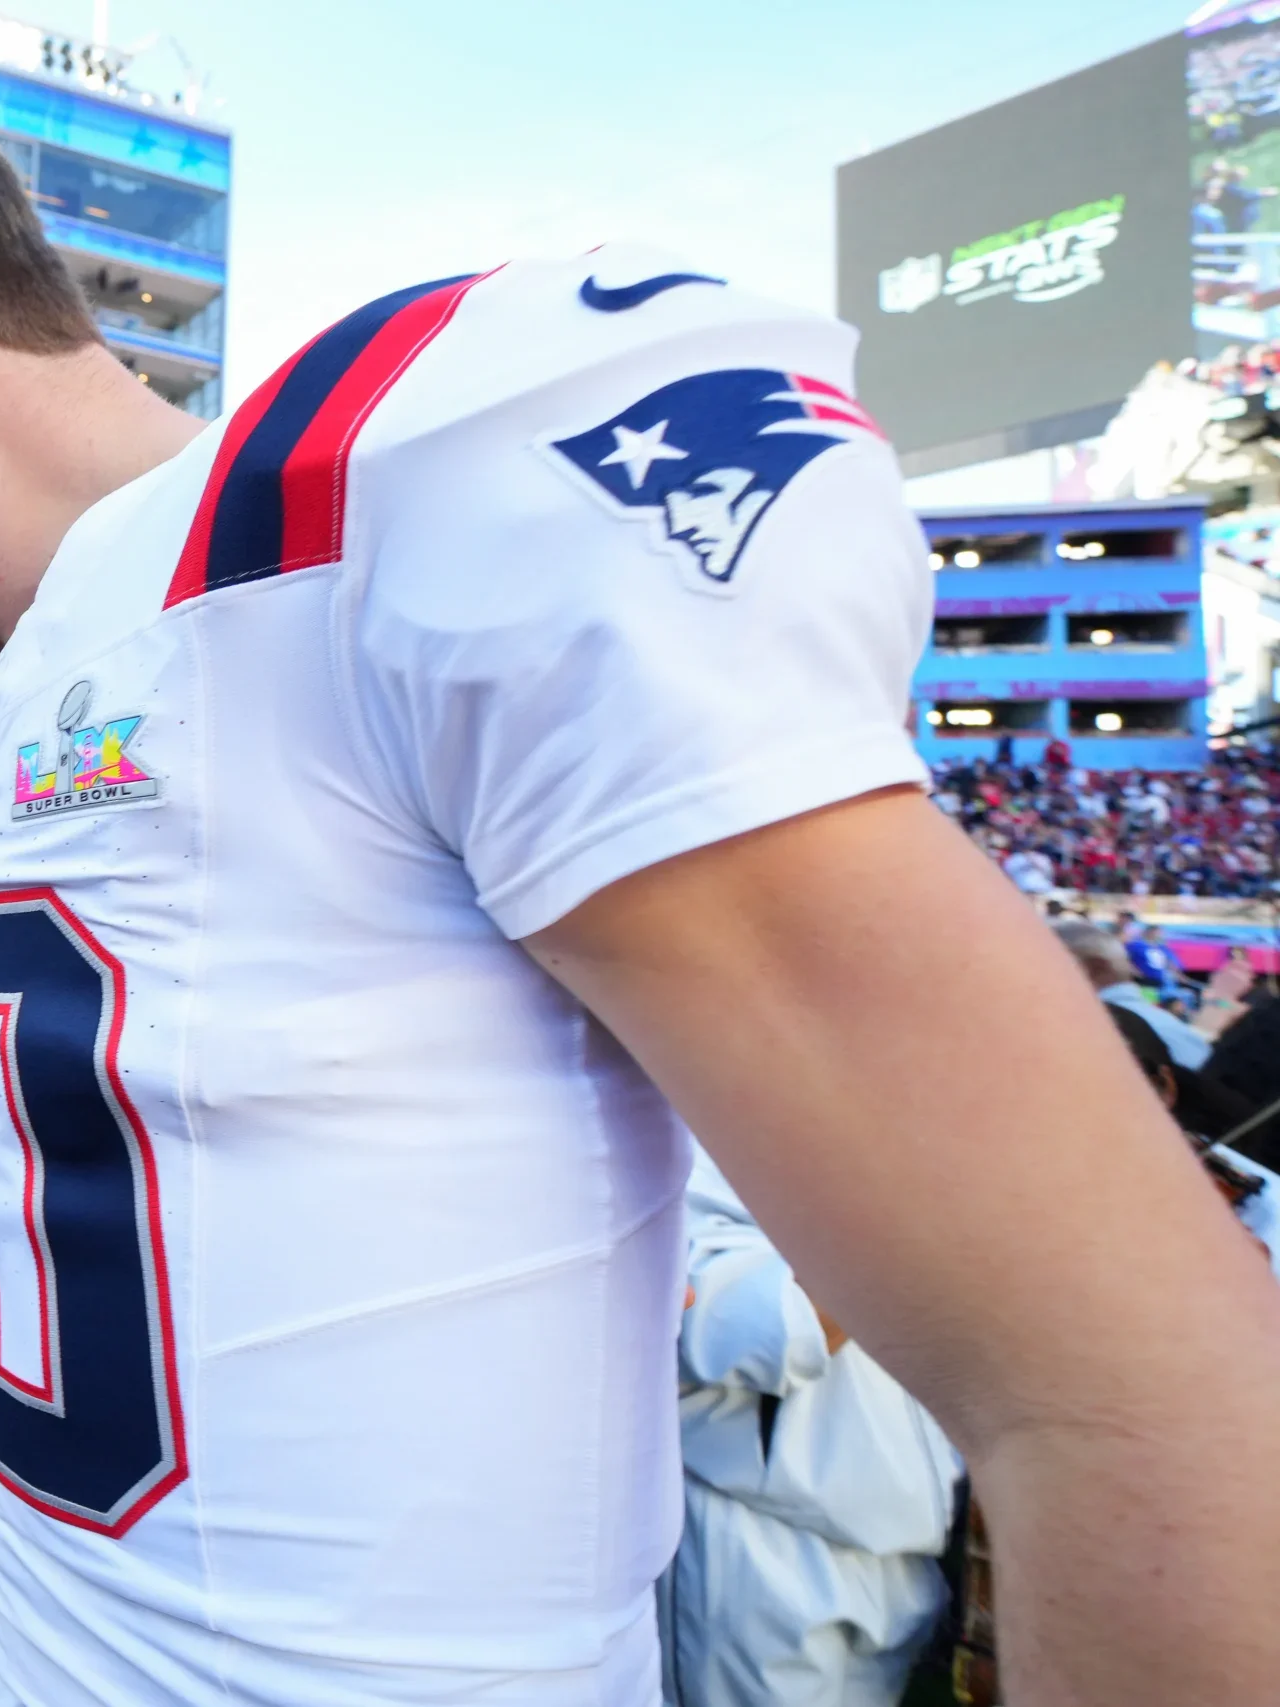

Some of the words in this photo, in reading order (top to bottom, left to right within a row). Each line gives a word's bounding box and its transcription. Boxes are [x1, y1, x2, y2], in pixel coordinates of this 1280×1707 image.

[942, 212, 1122, 296] STATS
[25, 794, 73, 813] SUPER
[80, 785, 132, 803] BOWL
